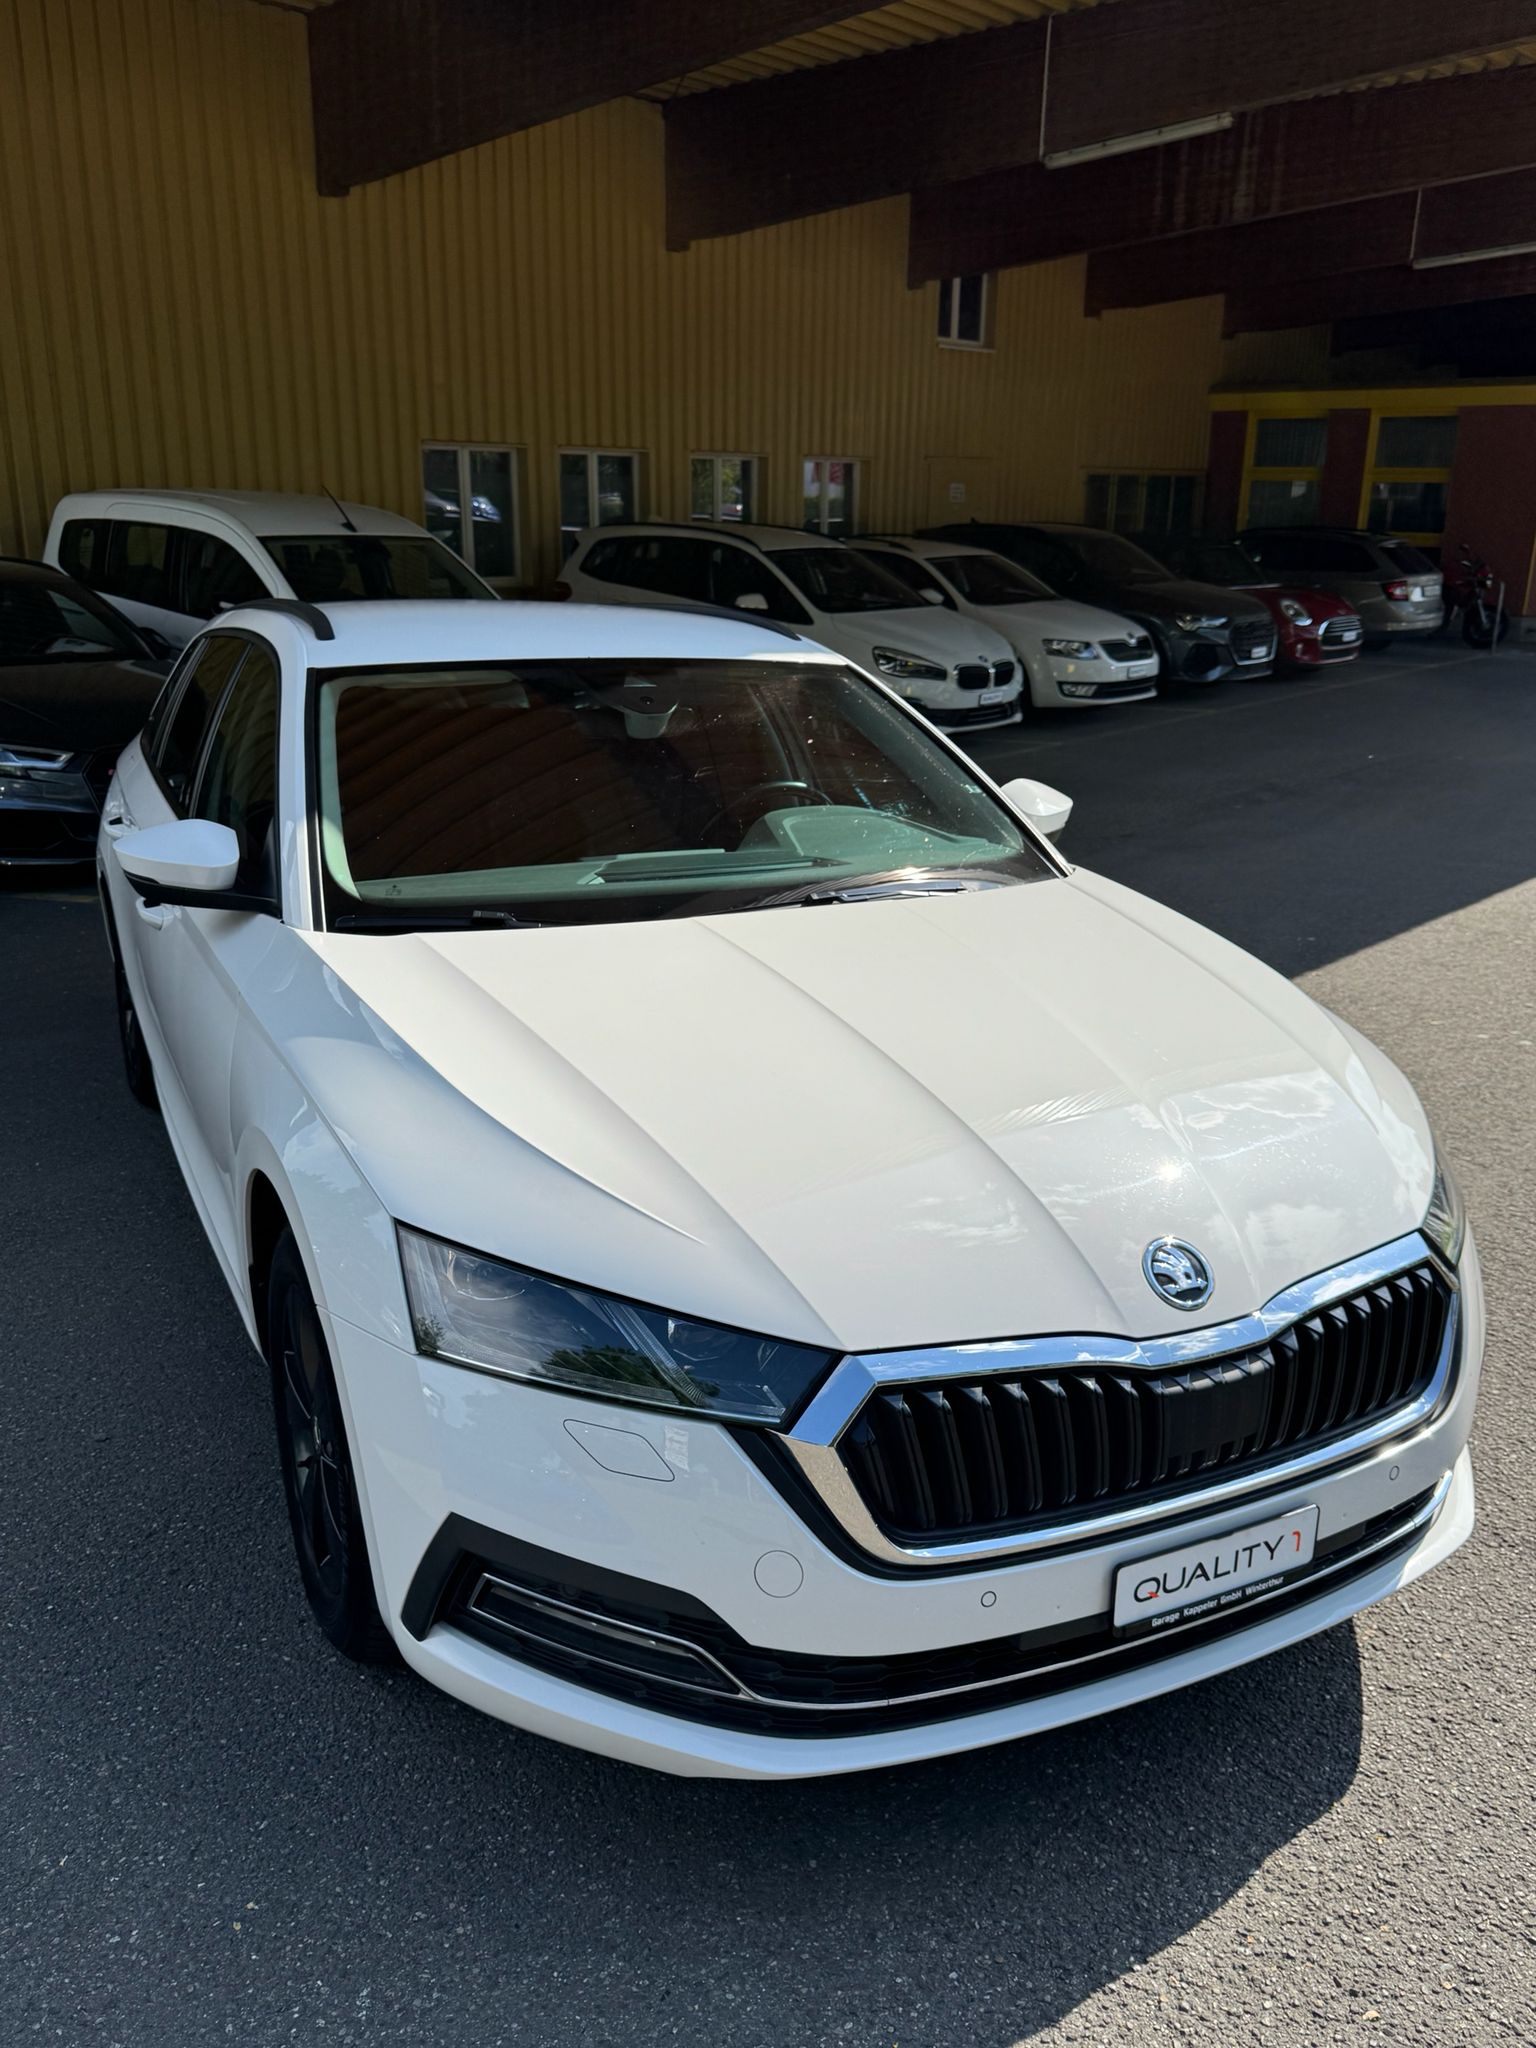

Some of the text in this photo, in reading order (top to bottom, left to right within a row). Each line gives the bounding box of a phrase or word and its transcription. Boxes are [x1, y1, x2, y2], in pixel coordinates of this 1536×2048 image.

[1133, 1530, 1301, 1603] QUALITY 1
[1151, 1576, 1284, 1627] Garage Kappeler GmbH Winterthur
